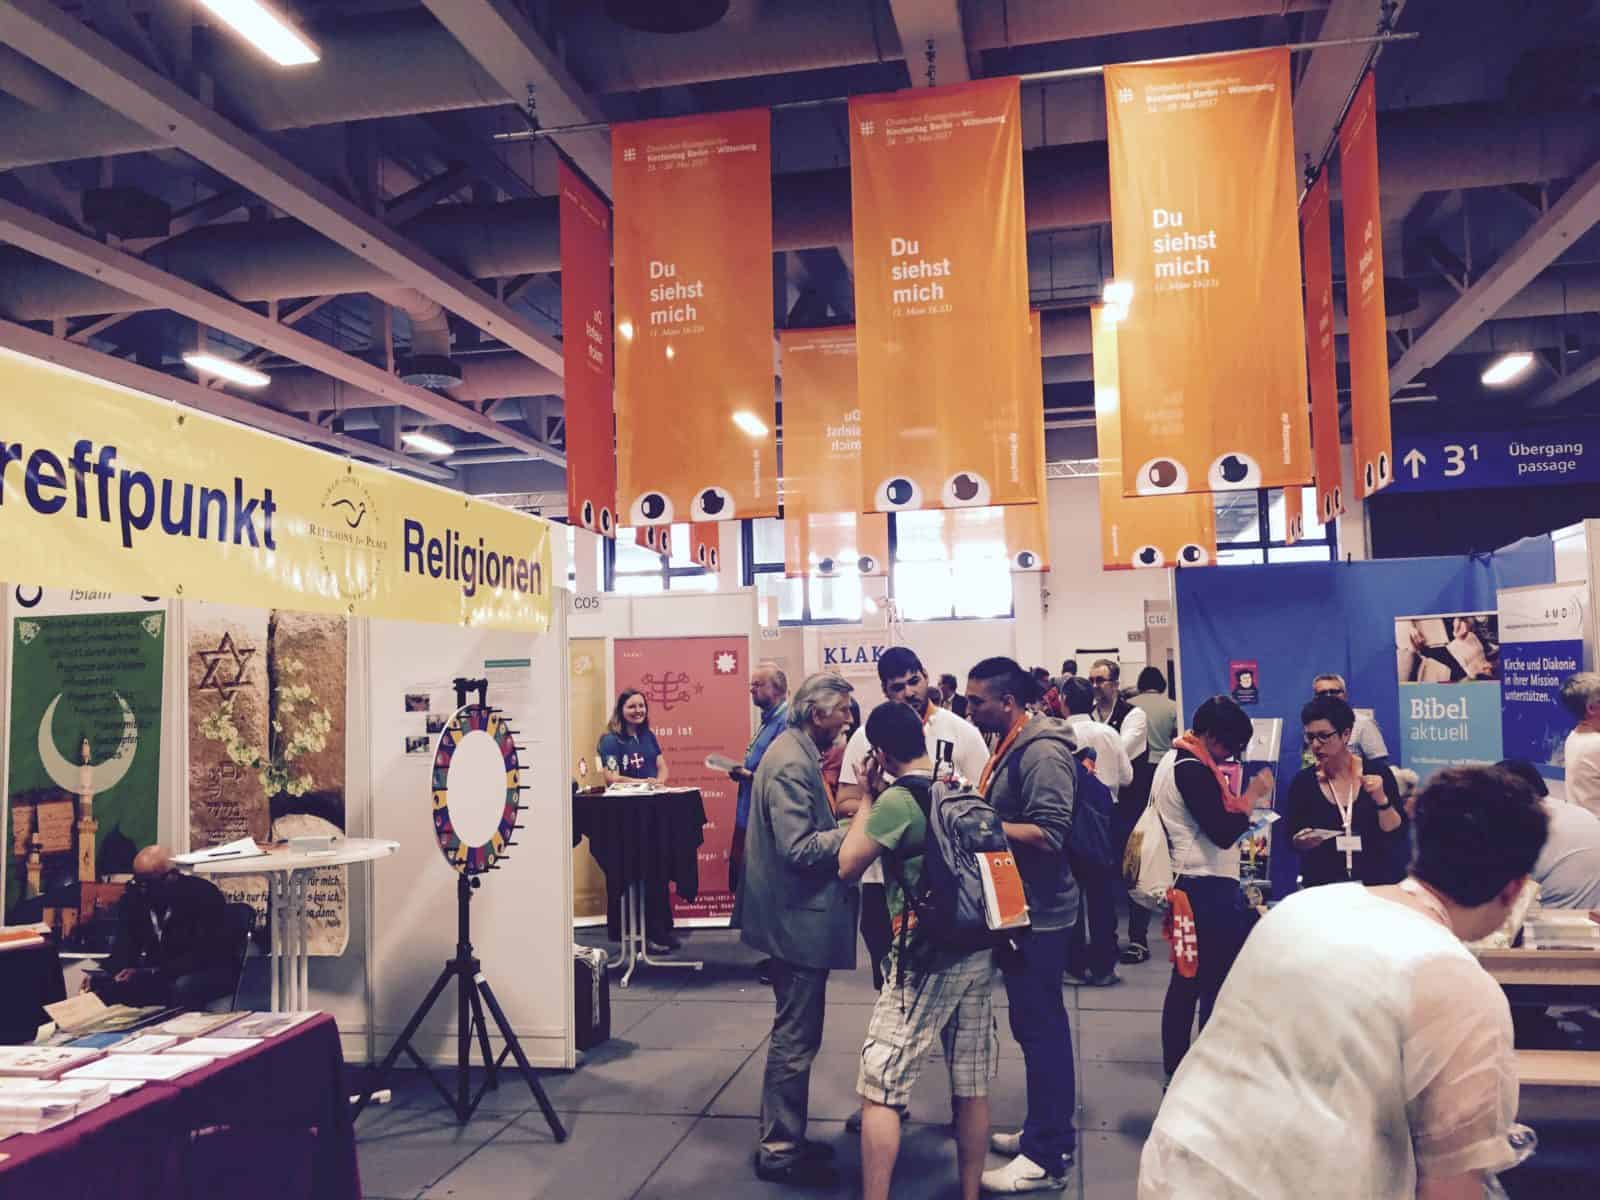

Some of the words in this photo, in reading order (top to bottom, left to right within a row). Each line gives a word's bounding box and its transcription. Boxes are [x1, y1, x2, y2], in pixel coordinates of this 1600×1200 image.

[1153, 209, 1183, 229] Du
[891, 237, 919, 256] Du
[1153, 229, 1217, 253] siehst
[650, 261, 675, 279] Du
[892, 257, 951, 280] siehst
[1154, 254, 1210, 278] mich
[650, 280, 704, 302] siehst
[893, 282, 944, 304] mich
[651, 303, 697, 325] mich
[1508, 442, 1583, 457] Übergang
[1518, 460, 1576, 475] passage
[404, 518, 543, 597] Religionen
[574, 596, 600, 609] C05
[1504, 657, 1525, 671] Kirche
[1526, 657, 1541, 670] und
[1542, 656, 1577, 671] Diakonie
[1504, 672, 1511, 686] in
[1513, 672, 1529, 686] ihrer
[1530, 672, 1559, 686] Mission
[1411, 696, 1469, 720] Bibel
[1410, 719, 1468, 741] aktuell
